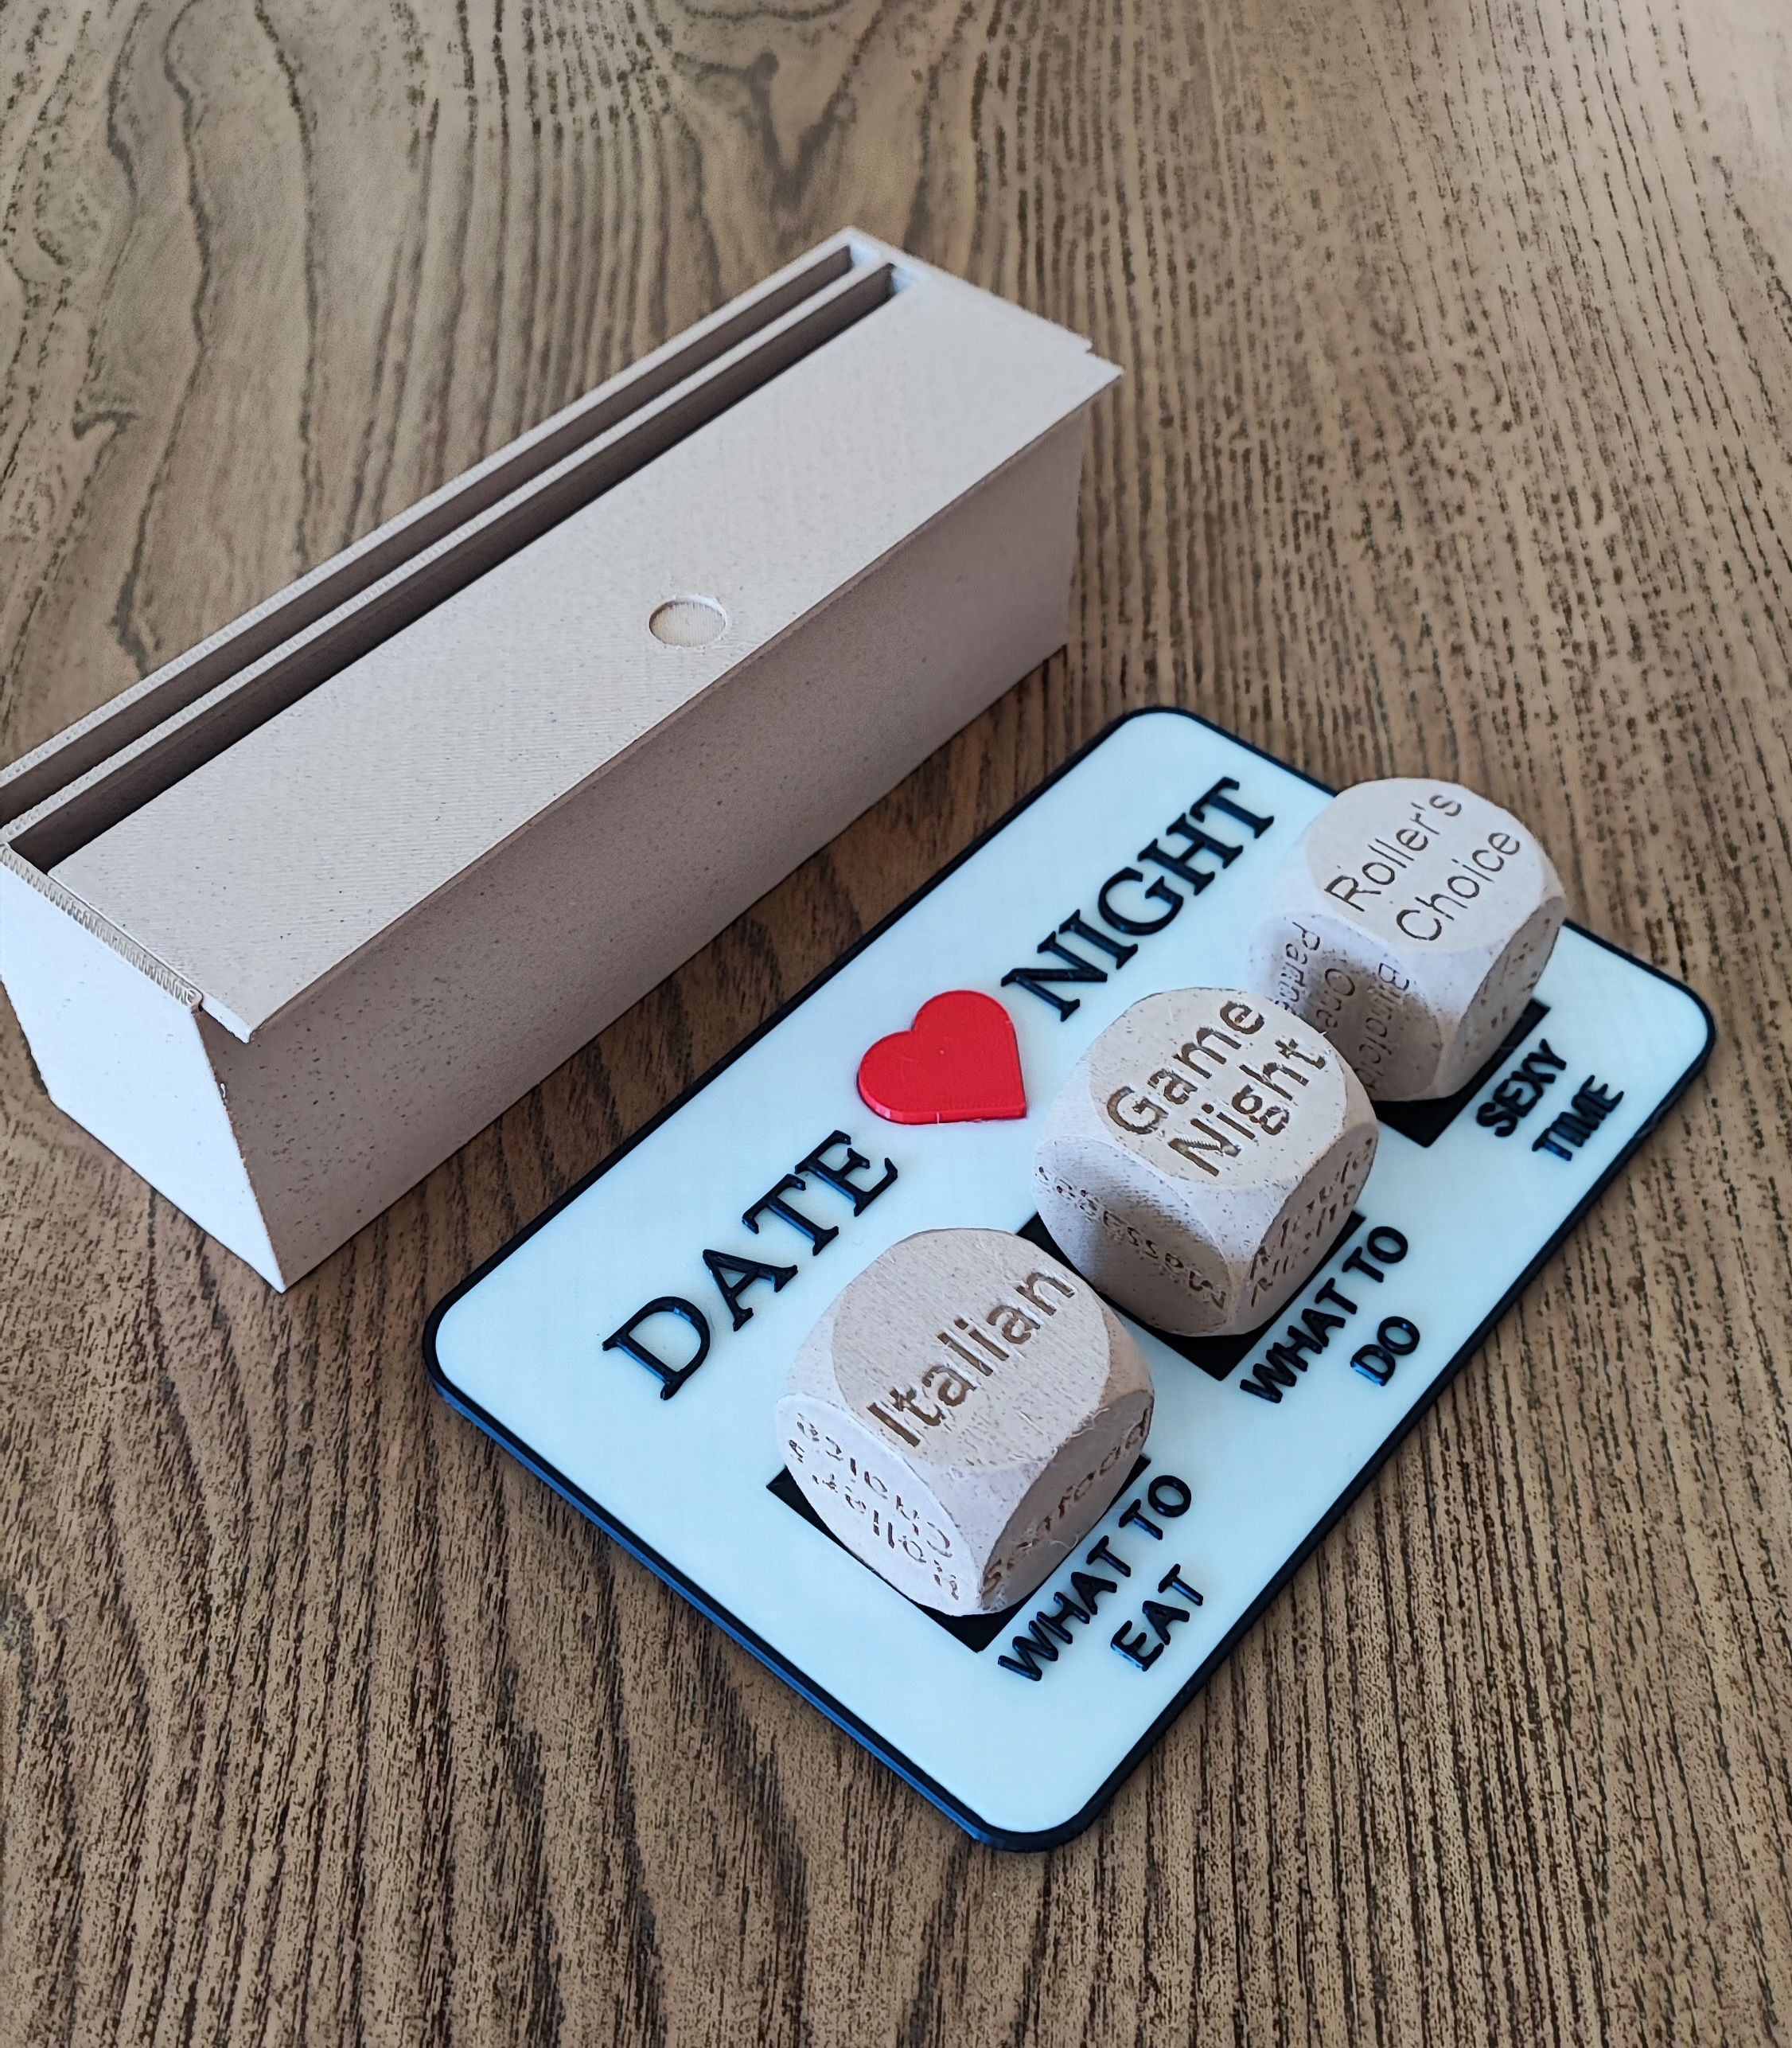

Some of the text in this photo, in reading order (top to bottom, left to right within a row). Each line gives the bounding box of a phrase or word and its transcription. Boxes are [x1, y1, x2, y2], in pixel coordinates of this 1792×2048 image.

[1323, 794, 1463, 912] Roller's
[1396, 831, 1521, 942] Choice
[1316, 968, 1356, 1029] One
[602, 777, 1275, 1400] DATE NIGHT
[1106, 1000, 1265, 1136] Game
[1167, 1038, 1330, 1177] Night
[1475, 1038, 1567, 1138] SEXY
[1532, 1075, 1625, 1162] TIME
[867, 1270, 1078, 1448] Italian
[1239, 1226, 1408, 1403] WHAT TO
[1350, 1316, 1420, 1387] DO
[997, 1475, 1192, 1682] WHAT TO
[1111, 1564, 1204, 1672] EAT
